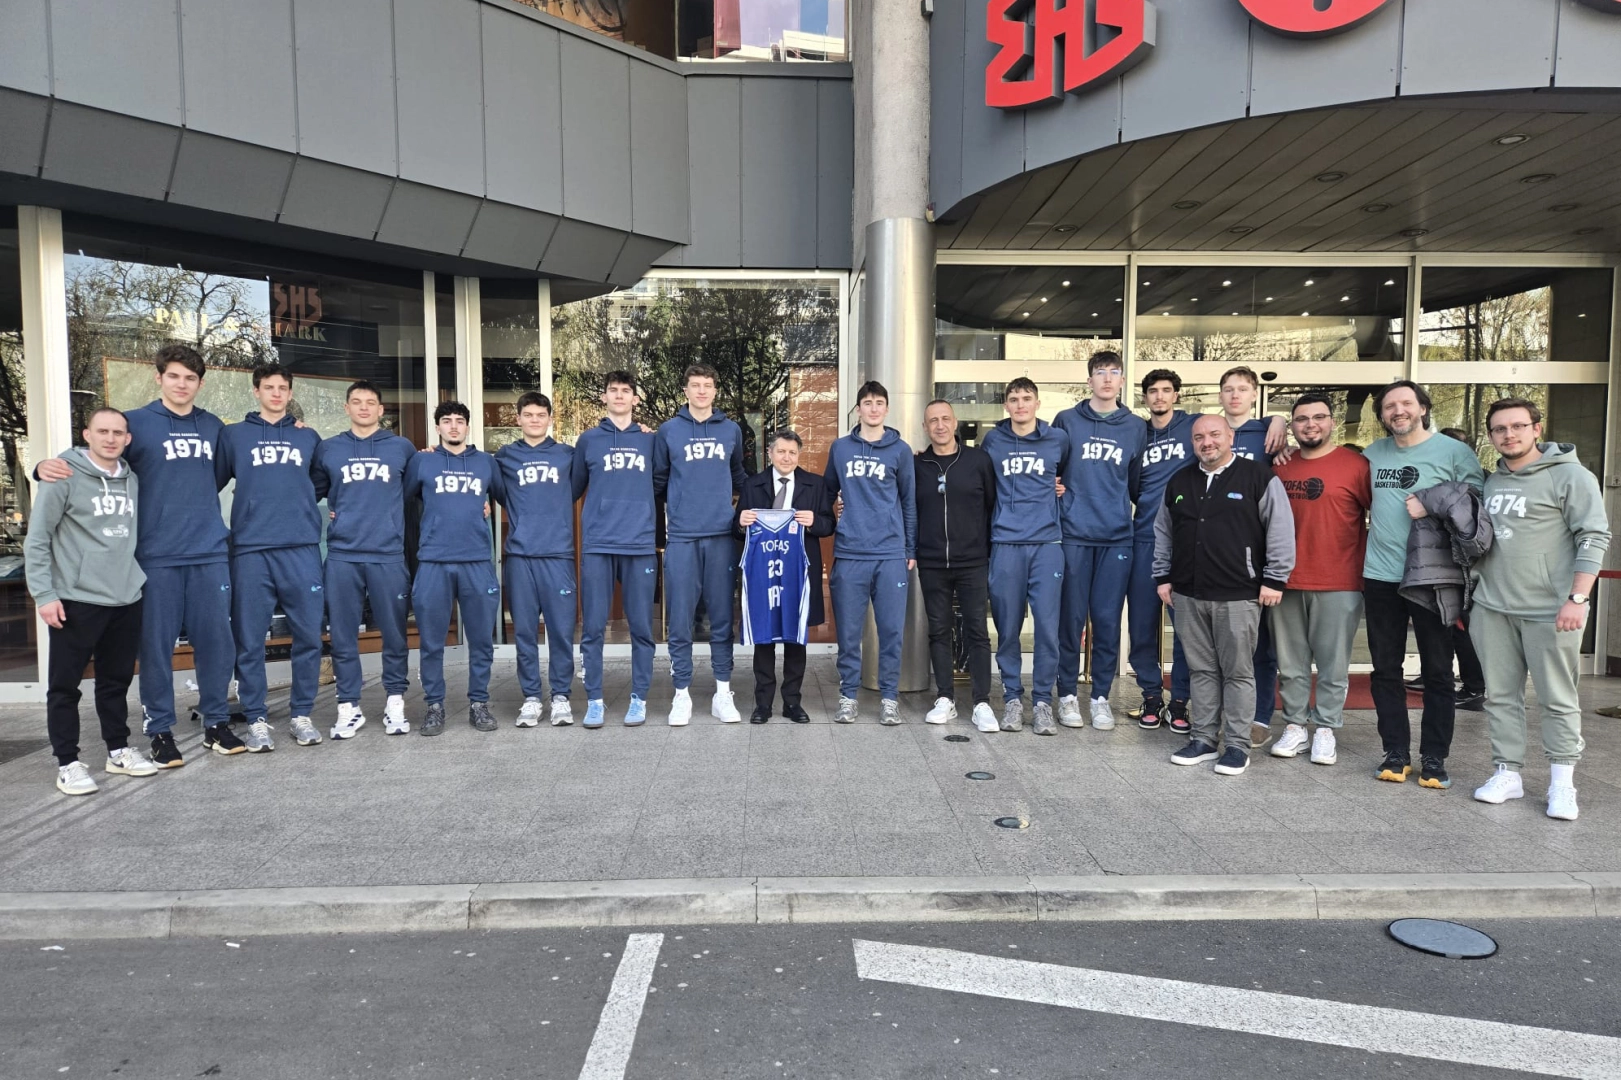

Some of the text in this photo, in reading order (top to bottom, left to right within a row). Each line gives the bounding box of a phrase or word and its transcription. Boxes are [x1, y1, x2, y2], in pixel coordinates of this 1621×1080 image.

[162, 438, 213, 460] 1974
[250, 445, 303, 467] 1974
[683, 441, 726, 462] 1974
[1081, 442, 1123, 466] 1974
[1142, 442, 1186, 468] 1974
[340, 462, 391, 484] 1974
[602, 452, 646, 472] 1974
[846, 459, 886, 481] 1974
[1001, 456, 1046, 476] 1974
[434, 475, 482, 496] 1974
[516, 465, 559, 487] 1974
[91, 494, 135, 518] 1974
[1484, 494, 1527, 517] 1974
[767, 558, 784, 579] 23
